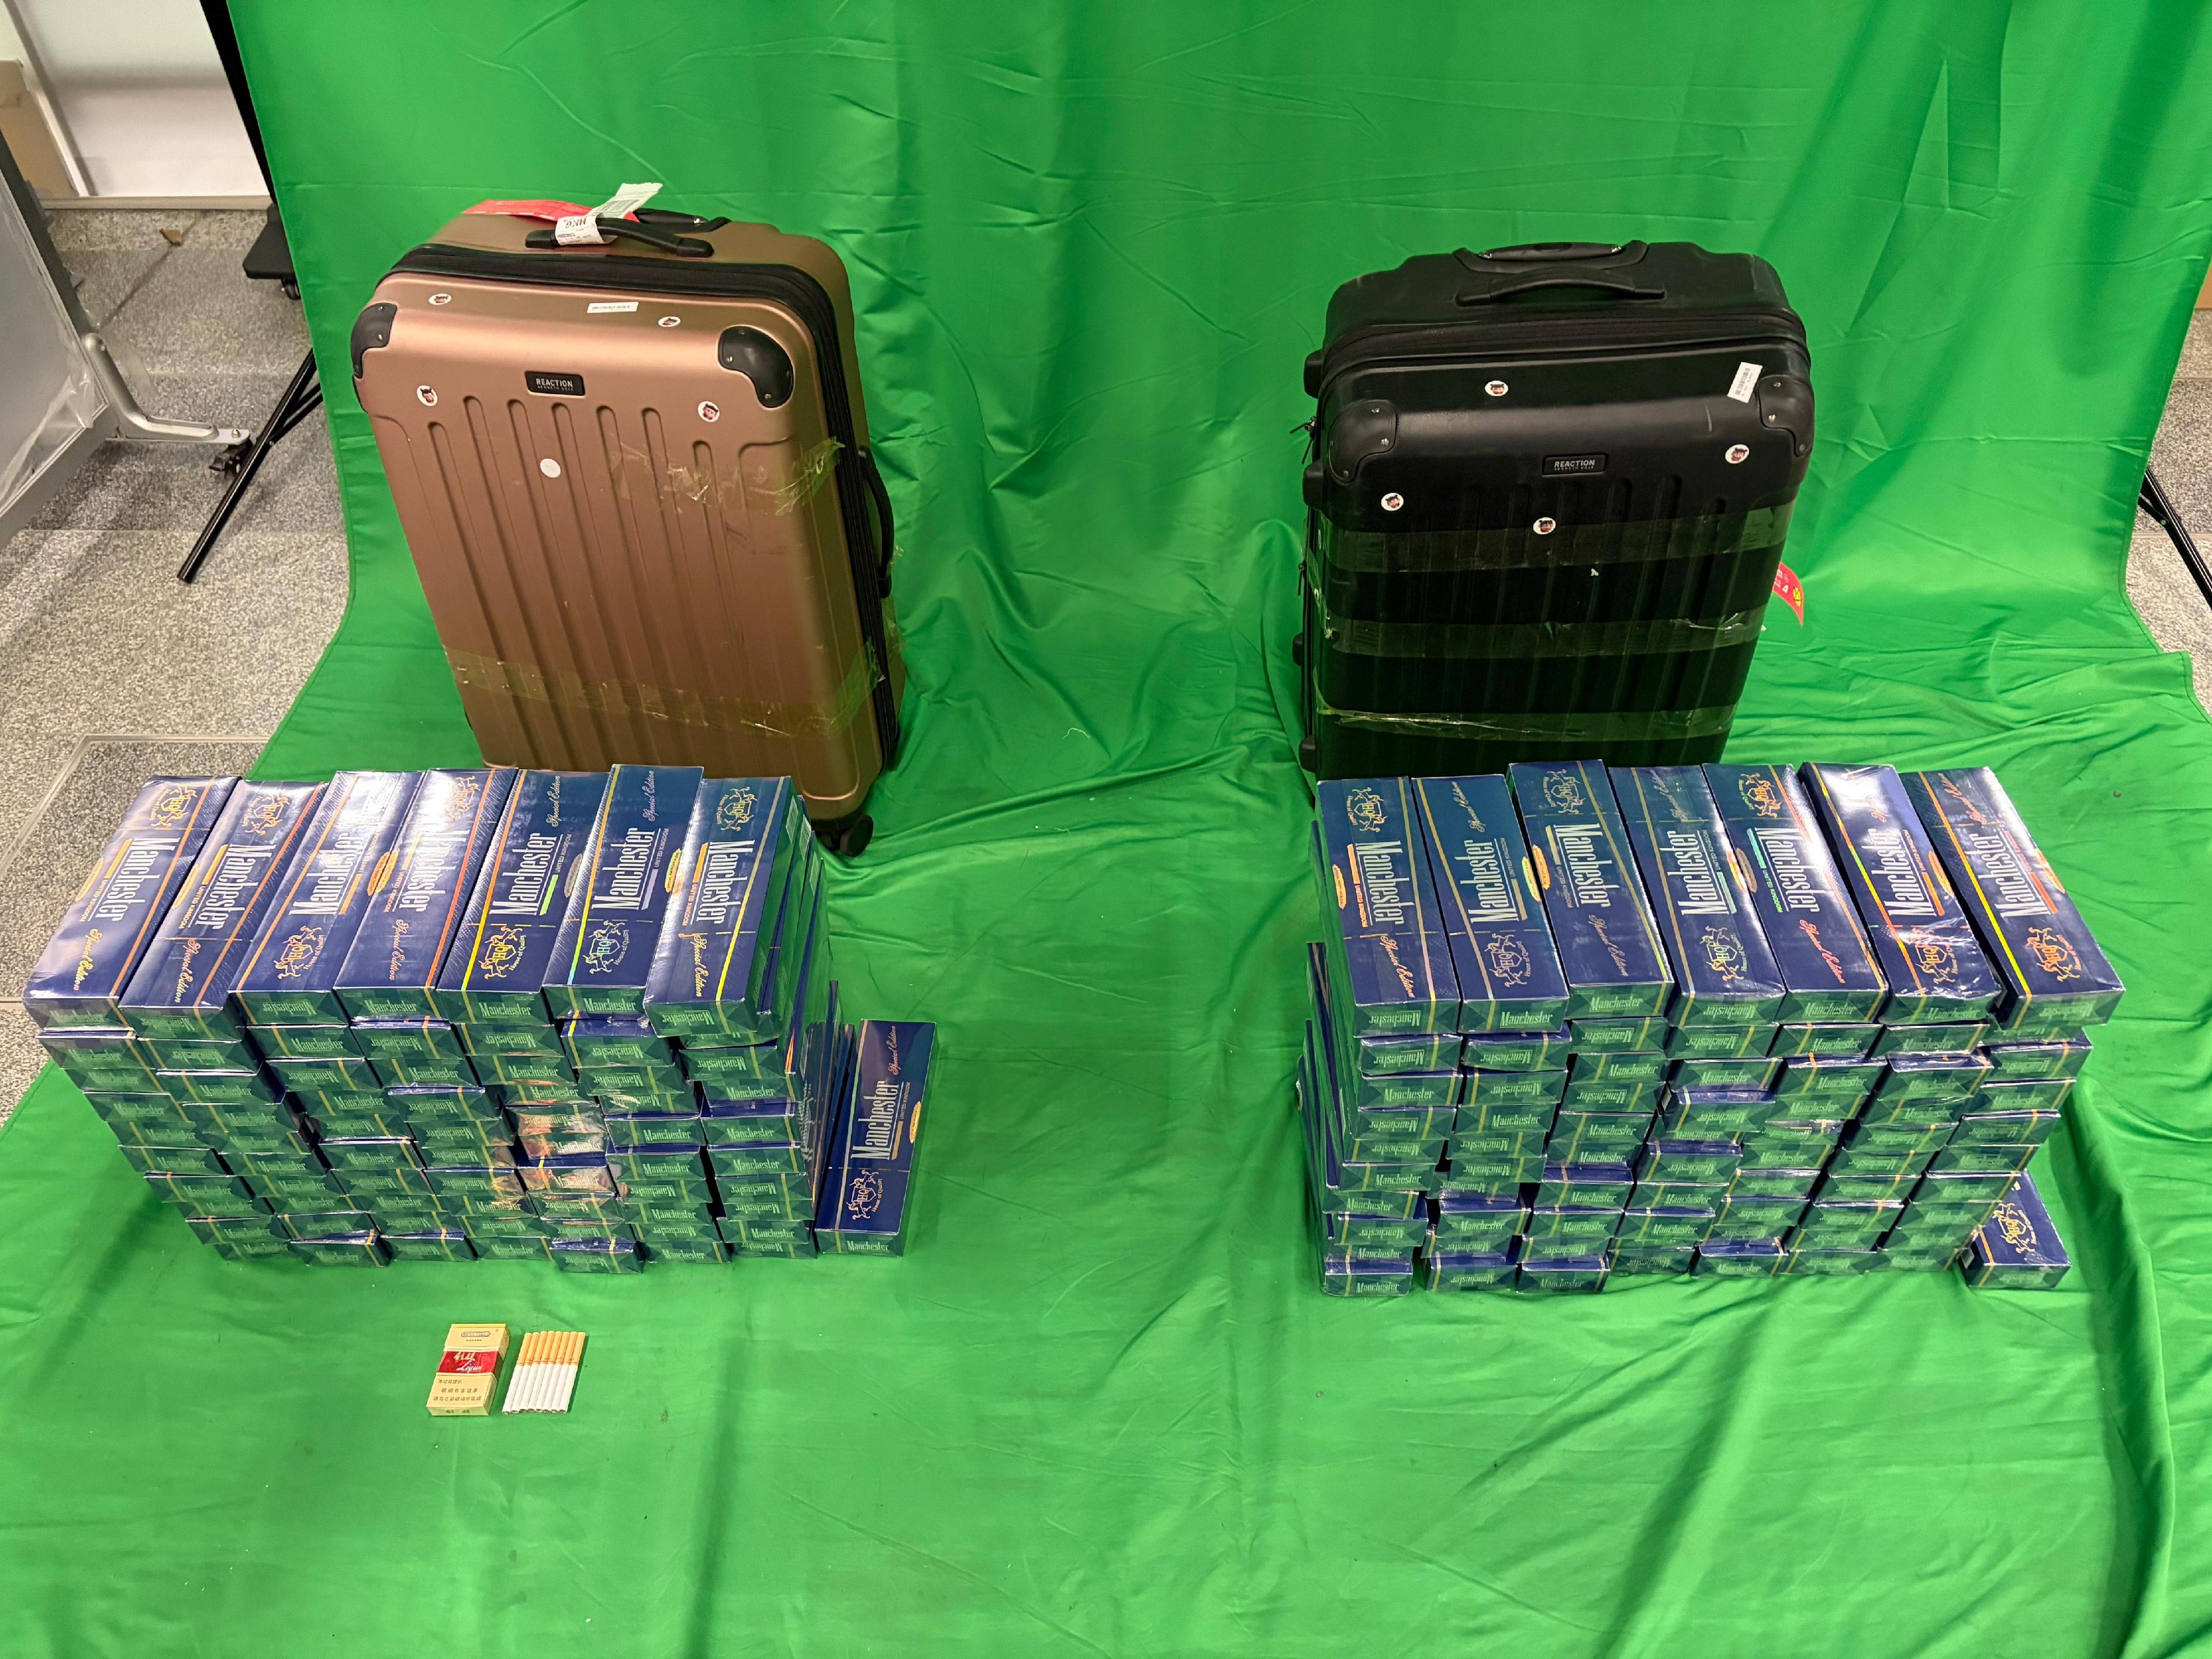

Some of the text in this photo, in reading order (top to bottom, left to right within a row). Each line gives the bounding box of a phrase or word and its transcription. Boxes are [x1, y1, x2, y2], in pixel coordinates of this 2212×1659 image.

[565, 218, 586, 229] HKG
[536, 378, 573, 387] REACTION
[1554, 460, 1595, 468] REACTION
[546, 775, 562, 827] Special Edition
[642, 770, 659, 822] Special Edition
[554, 834, 572, 873] UNITED KINGDOM
[654, 828, 669, 867] UNITED KINGDOM
[359, 855, 370, 874] UNITED
[592, 827, 655, 910] Manchester
[1506, 858, 1516, 877] UNITED
[1553, 823, 1620, 907] Manchester
[1711, 852, 1721, 871] UNITED
[1914, 852, 1926, 870] UNITED
[289, 833, 365, 916] Manchester
[399, 830, 470, 912] Manchester
[489, 833, 557, 916] Manchester
[1659, 831, 1729, 915] Manchester
[1754, 827, 1830, 912] Manchester
[1861, 828, 1936, 917] Manchester
[1964, 833, 2051, 917] Manchester
[95, 837, 180, 921] Manchester
[195, 844, 276, 930] Manchester
[393, 872, 402, 890] UNITED
[696, 840, 755, 924] Manchester
[1356, 840, 1415, 925] Manchester
[1454, 839, 1519, 923] Manchester
[93, 879, 108, 896] UNITED
[192, 886, 206, 905] UNITED
[1556, 867, 1573, 908] UNITED KINGDOM
[1763, 870, 1783, 912] UNITED KINGDOM
[384, 890, 396, 912] KINGDOM
[681, 884, 697, 926] UNITED KINGDOM
[1354, 885, 1368, 928] UNITED KINGDOM
[80, 897, 98, 922] KINGDOM
[179, 906, 196, 929] KINGDOM
[389, 920, 409, 980] Special Edition
[509, 956, 521, 971] House
[518, 935, 526, 947] Quality
[1588, 915, 1629, 977] Special Edition
[1799, 920, 1845, 983] Special Edition
[74, 929, 102, 990] Special Edition
[614, 952, 625, 966] House
[692, 935, 709, 997] Special Edition
[1380, 934, 1415, 998] Special Edition
[175, 939, 201, 1003] Special Edition
[263, 1001, 316, 1015] Manchester
[364, 1000, 418, 1014] Manchester
[479, 1002, 531, 1017] Manchester
[583, 997, 635, 1013] Manchester
[1589, 997, 1642, 1011] Manchester
[1703, 1004, 1756, 1018] Manchester
[1804, 1003, 1857, 1018] Manchester
[662, 1010, 714, 1025] Manchester
[1369, 1010, 1421, 1026] Manchester
[1500, 1011, 1553, 1026] Manchester
[486, 1034, 536, 1048] Manchester
[1582, 1029, 1634, 1042] Manchester
[1686, 1034, 1739, 1048] Manchester
[291, 1037, 343, 1052] Manchester
[592, 1045, 643, 1058] Manchester
[886, 1025, 901, 1075] Special Edition
[1811, 1037, 1861, 1052] Manchester
[697, 1057, 746, 1070] Manchester
[1373, 1049, 1425, 1065] Manchester
[1481, 1049, 1532, 1064] Manchester
[408, 1067, 459, 1081] Manchester
[508, 1065, 559, 1078] Manchester
[1608, 1063, 1658, 1077] Manchester
[1700, 1071, 1751, 1085] Manchester
[1490, 1082, 1541, 1096] Manchester
[1817, 1076, 1867, 1089] Manchester
[199, 1085, 251, 1097] Manchester
[531, 1086, 578, 1098] Manchester
[726, 1086, 775, 1099] Manchester
[902, 1082, 910, 1102] KINGDOM
[1384, 1088, 1434, 1101] Manchester
[1577, 1090, 1627, 1104] Manchester
[851, 1080, 899, 1160] Manchester
[1369, 1118, 1418, 1131] Manchester
[1491, 1114, 1540, 1127] Manchester
[643, 1129, 691, 1143] Manchester
[726, 1128, 774, 1140] Manchester
[1589, 1124, 1636, 1138] Manchester
[643, 1162, 690, 1175] Manchester
[733, 1160, 779, 1172] Manchester
[1375, 1173, 1422, 1187] Manchester
[872, 1200, 881, 1212] House
[1346, 1198, 1393, 1211] Manchester
[751, 1228, 795, 1239] Manchester
[1358, 1228, 1404, 1239] Manchester
[847, 1240, 889, 1252] Manchester
